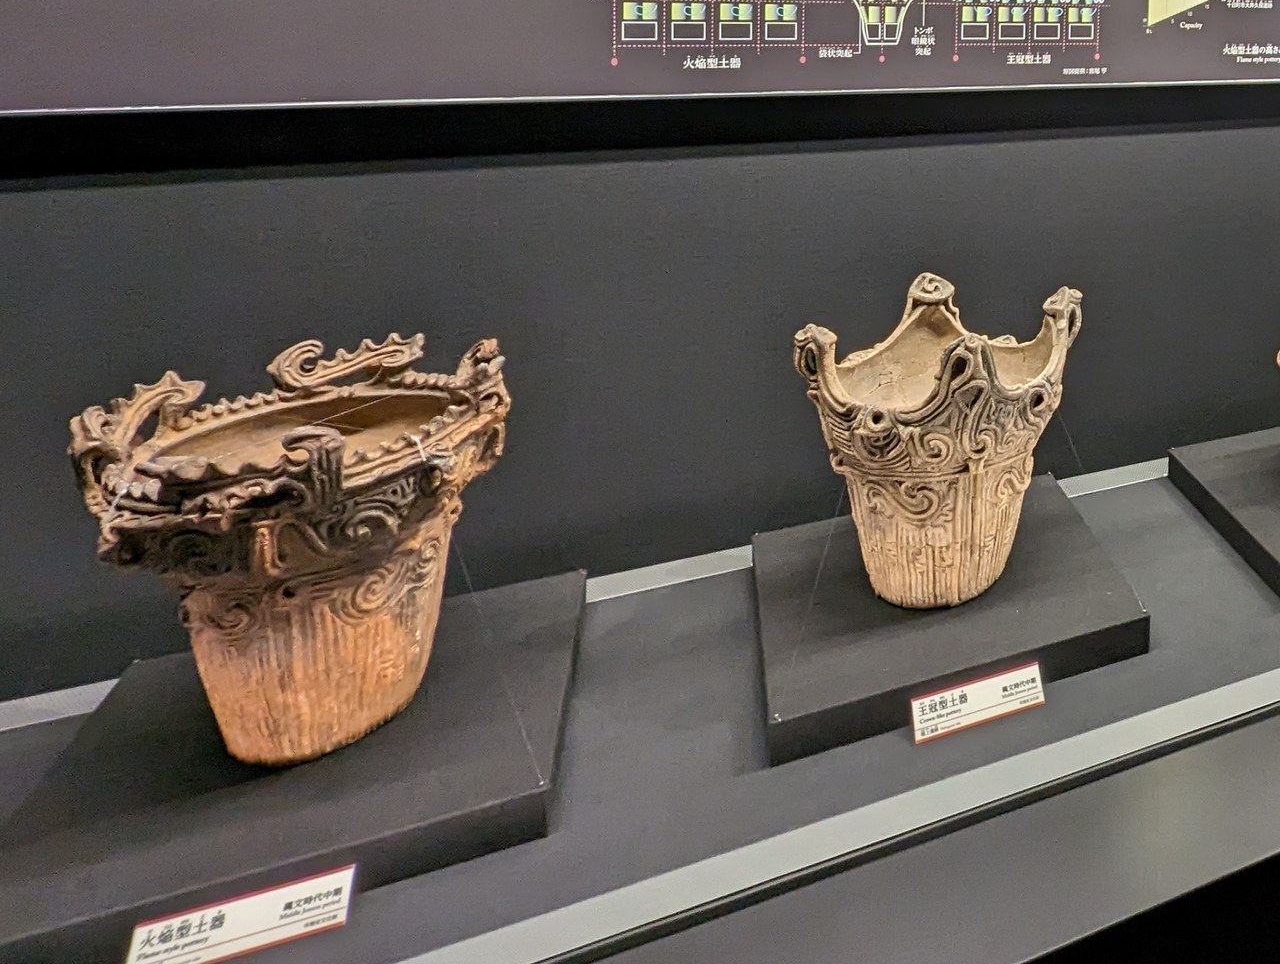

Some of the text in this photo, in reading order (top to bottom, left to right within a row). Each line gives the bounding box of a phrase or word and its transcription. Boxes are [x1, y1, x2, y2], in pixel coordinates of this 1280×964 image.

[1180, 22, 1203, 31] Capacity
[918, 692, 968, 717] 王冠型土器
[139, 913, 226, 951] 火焔型土器
